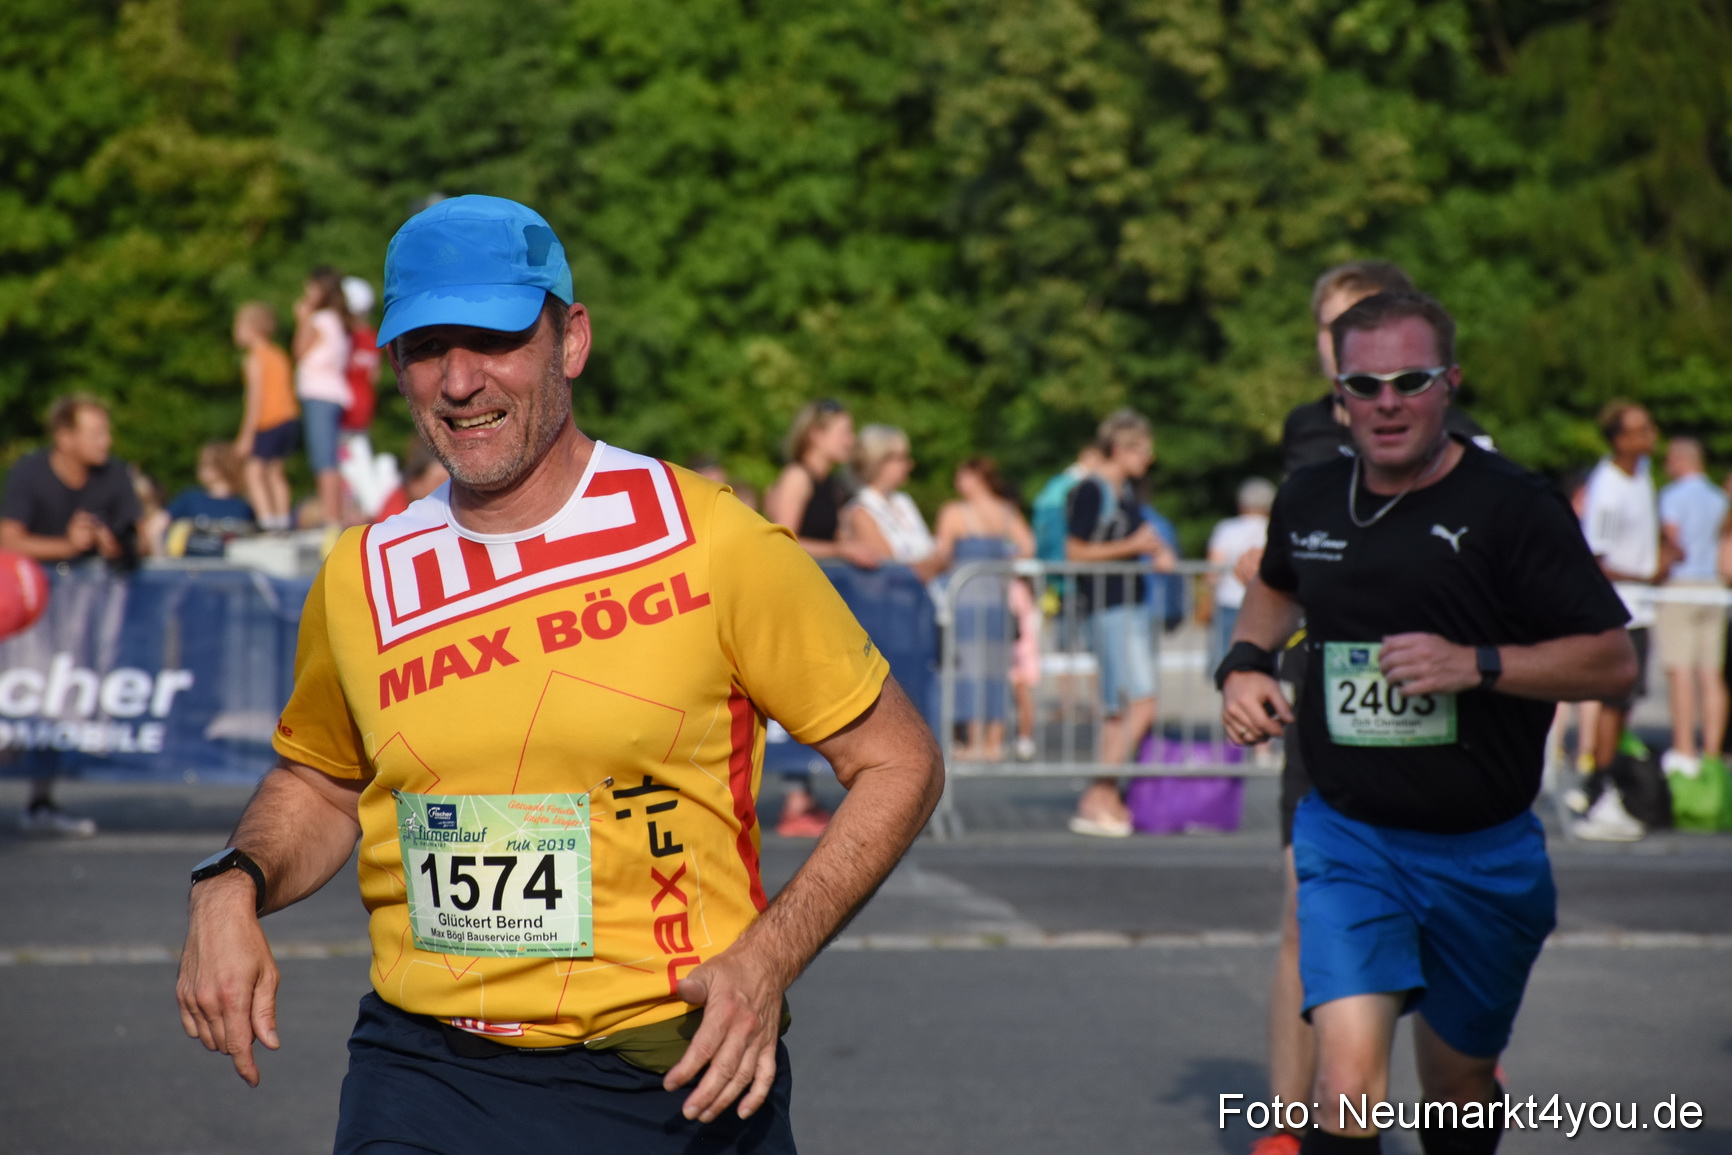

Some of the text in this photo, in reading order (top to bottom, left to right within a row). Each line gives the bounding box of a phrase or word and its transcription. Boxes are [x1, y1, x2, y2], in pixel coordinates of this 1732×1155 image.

[379, 571, 712, 711] MAX BÖGL
[1338, 679, 1437, 717] 2403
[418, 825, 488, 843] firmenlauf
[506, 838, 576, 852] run 2019
[420, 853, 563, 911] 1574
[438, 912, 543, 929] Glückert Bernd
[430, 928, 558, 943] Max Bögl Bauservice GmbH
